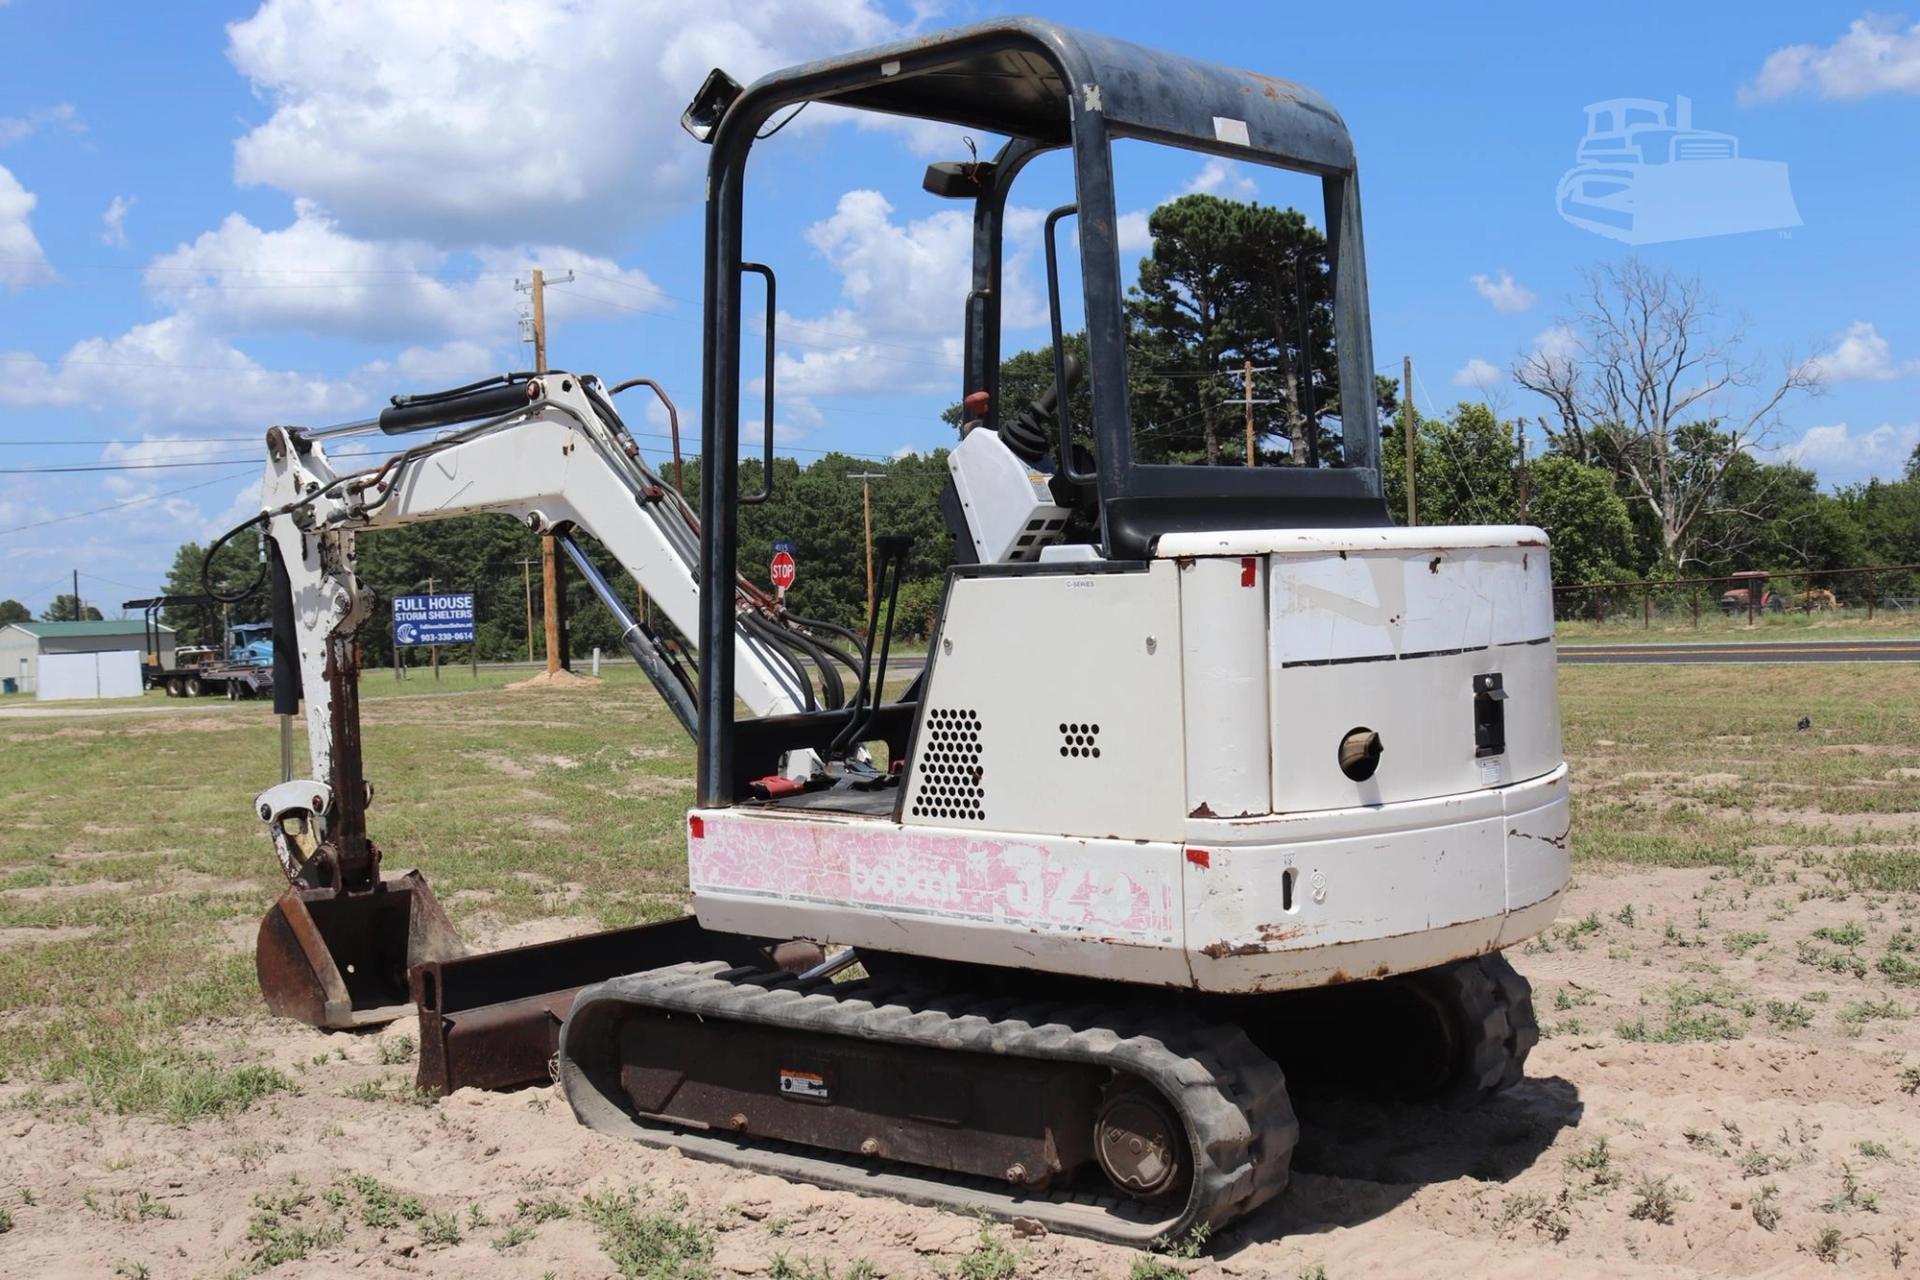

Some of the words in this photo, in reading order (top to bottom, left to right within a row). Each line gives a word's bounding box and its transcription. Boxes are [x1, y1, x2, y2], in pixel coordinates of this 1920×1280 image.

[773, 564, 793, 578] STOP
[394, 598, 426, 611] FULL
[429, 597, 472, 609] HOUSE
[395, 611, 427, 621] STORM
[428, 610, 472, 620] SHELTERS
